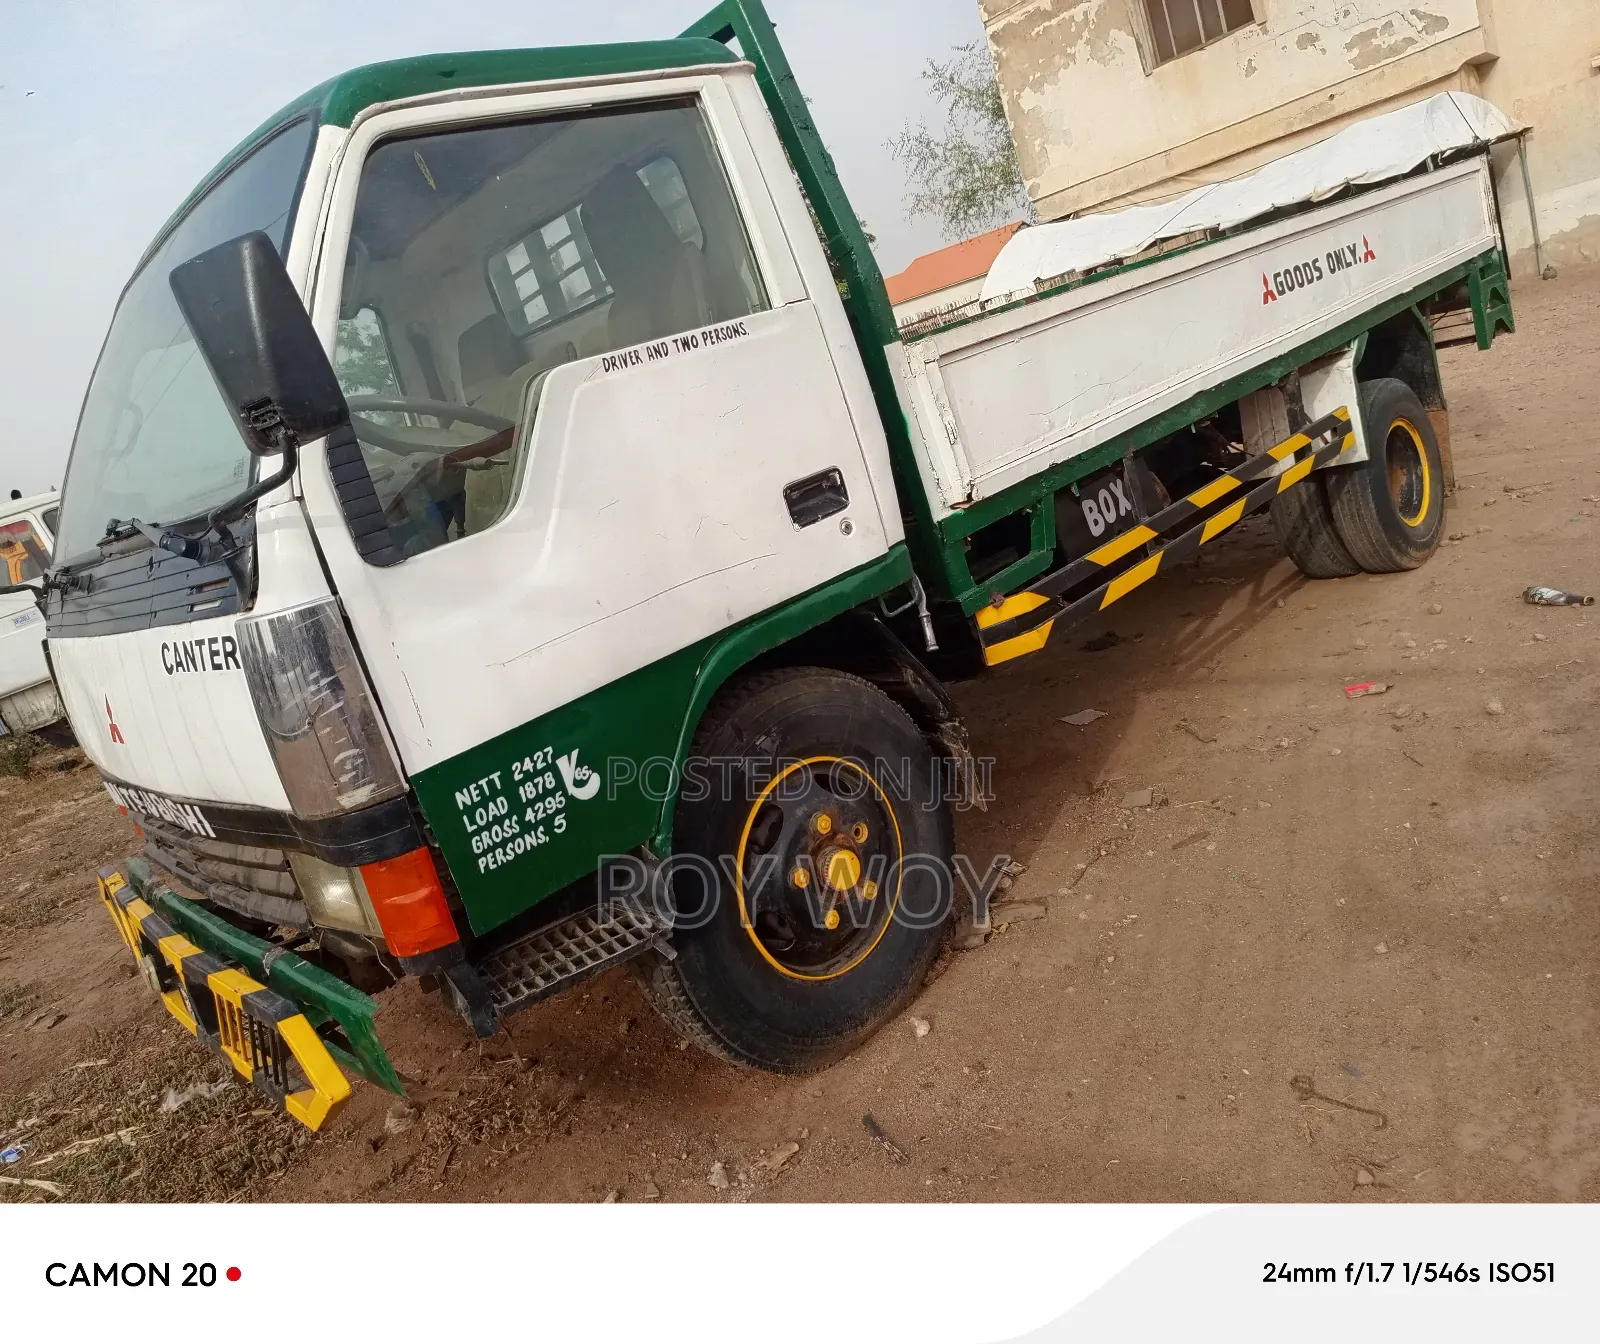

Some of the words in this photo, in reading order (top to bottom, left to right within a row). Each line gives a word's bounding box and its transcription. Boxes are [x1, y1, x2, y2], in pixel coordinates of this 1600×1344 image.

[1272, 257, 1323, 296] GOODS
[1325, 242, 1362, 275] ONLY.
[602, 349, 643, 373] DRIVER
[647, 341, 669, 361] AND
[672, 334, 699, 353] TWO
[1081, 478, 1132, 537] BOX
[161, 635, 242, 675] CANTER
[455, 771, 501, 810] NETT
[511, 746, 554, 781] 2427
[462, 796, 508, 833] LOAD
[518, 771, 556, 803] 1878
[471, 815, 520, 854] GROSS
[524, 790, 566, 824] 4295
[553, 813, 567, 833] 5
